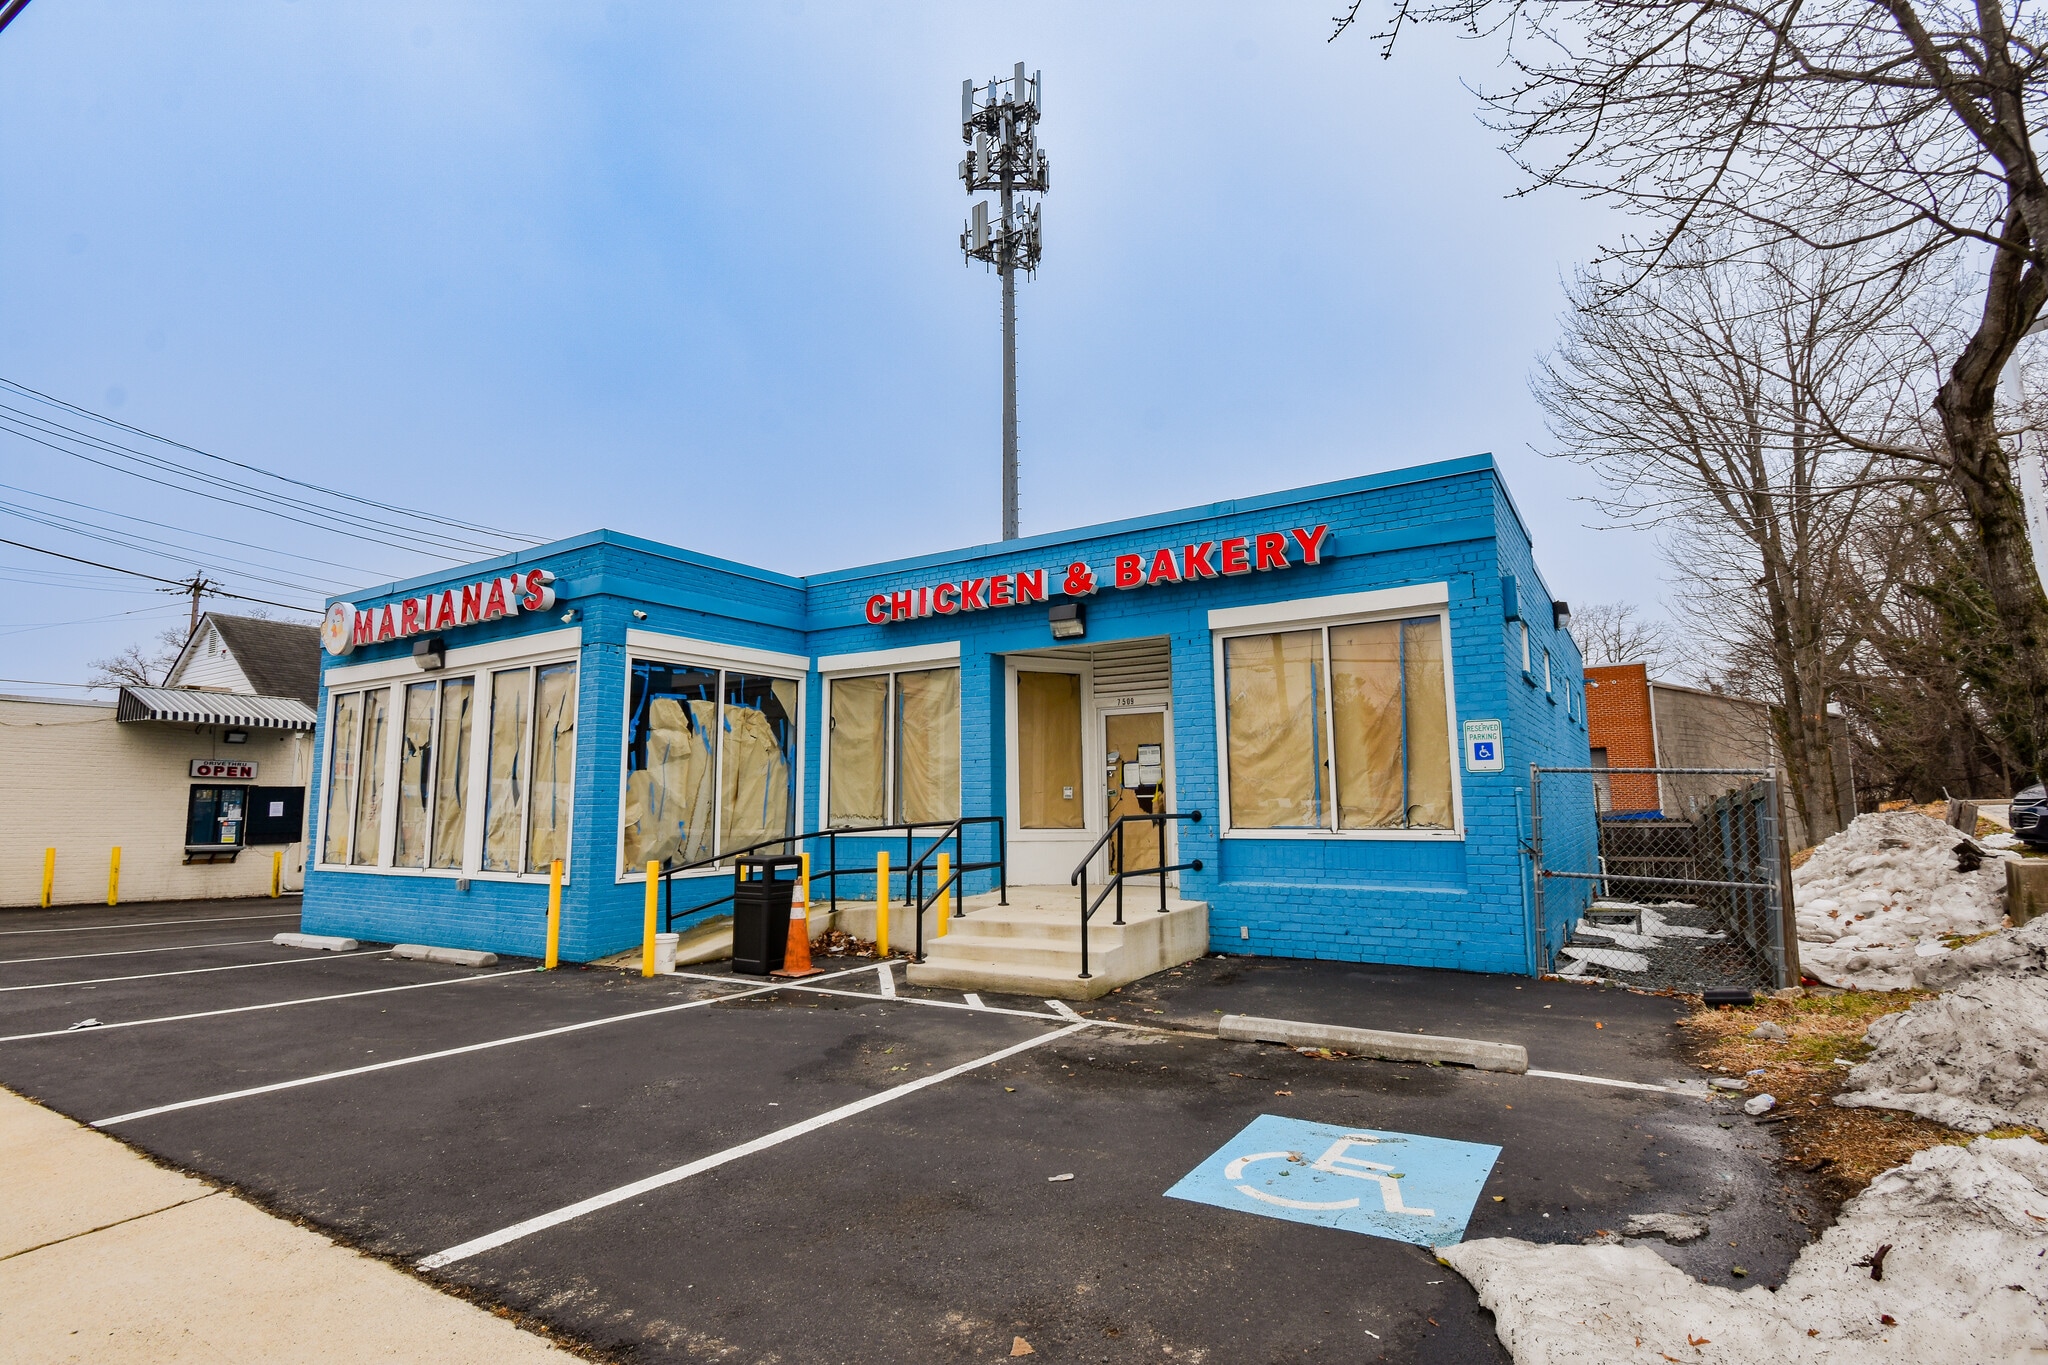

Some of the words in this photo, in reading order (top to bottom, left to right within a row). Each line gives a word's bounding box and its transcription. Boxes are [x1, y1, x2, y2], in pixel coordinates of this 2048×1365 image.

[865, 568, 1048, 625] CHICKEN
[1063, 561, 1098, 597] &
[1115, 524, 1330, 590] BAKERY
[352, 568, 556, 646] MARIANA'S
[1117, 697, 1134, 706] 7509
[1467, 724, 1498, 732] RESERVED
[197, 765, 252, 778] OPEN
